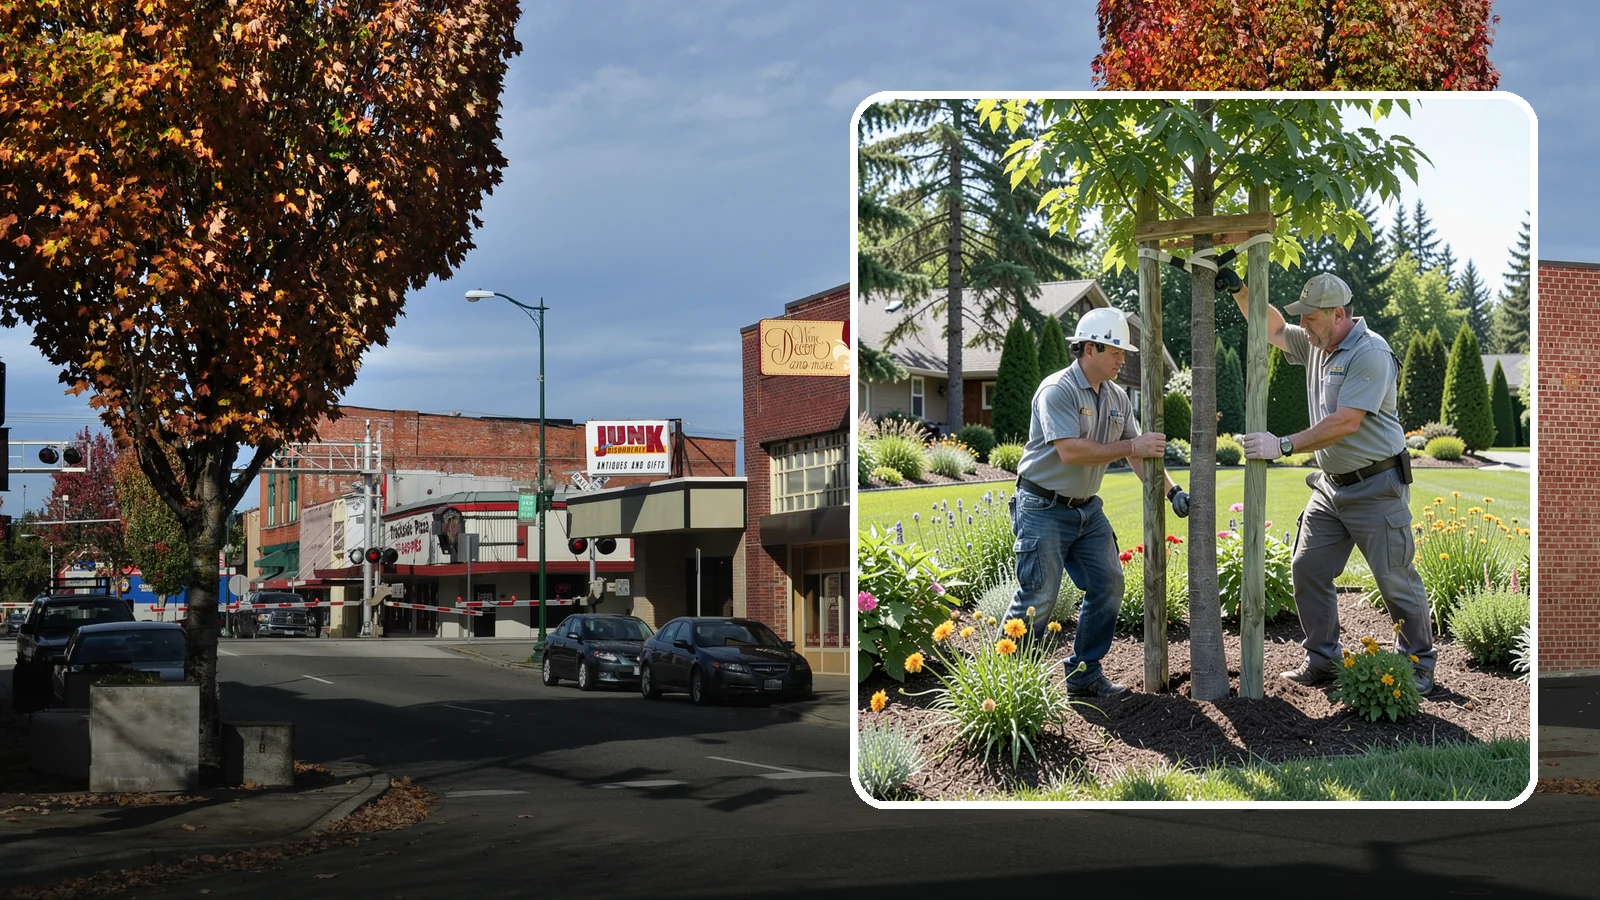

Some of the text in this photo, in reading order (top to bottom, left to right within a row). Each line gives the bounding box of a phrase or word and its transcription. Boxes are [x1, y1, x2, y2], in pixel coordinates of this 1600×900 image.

[765, 327, 831, 365] Decor
[596, 425, 664, 457] JUNK
[607, 446, 645, 455] DISORDERLY
[597, 460, 665, 470] ANTIQUES AND GIFTS
[414, 519, 429, 535] Pizza
